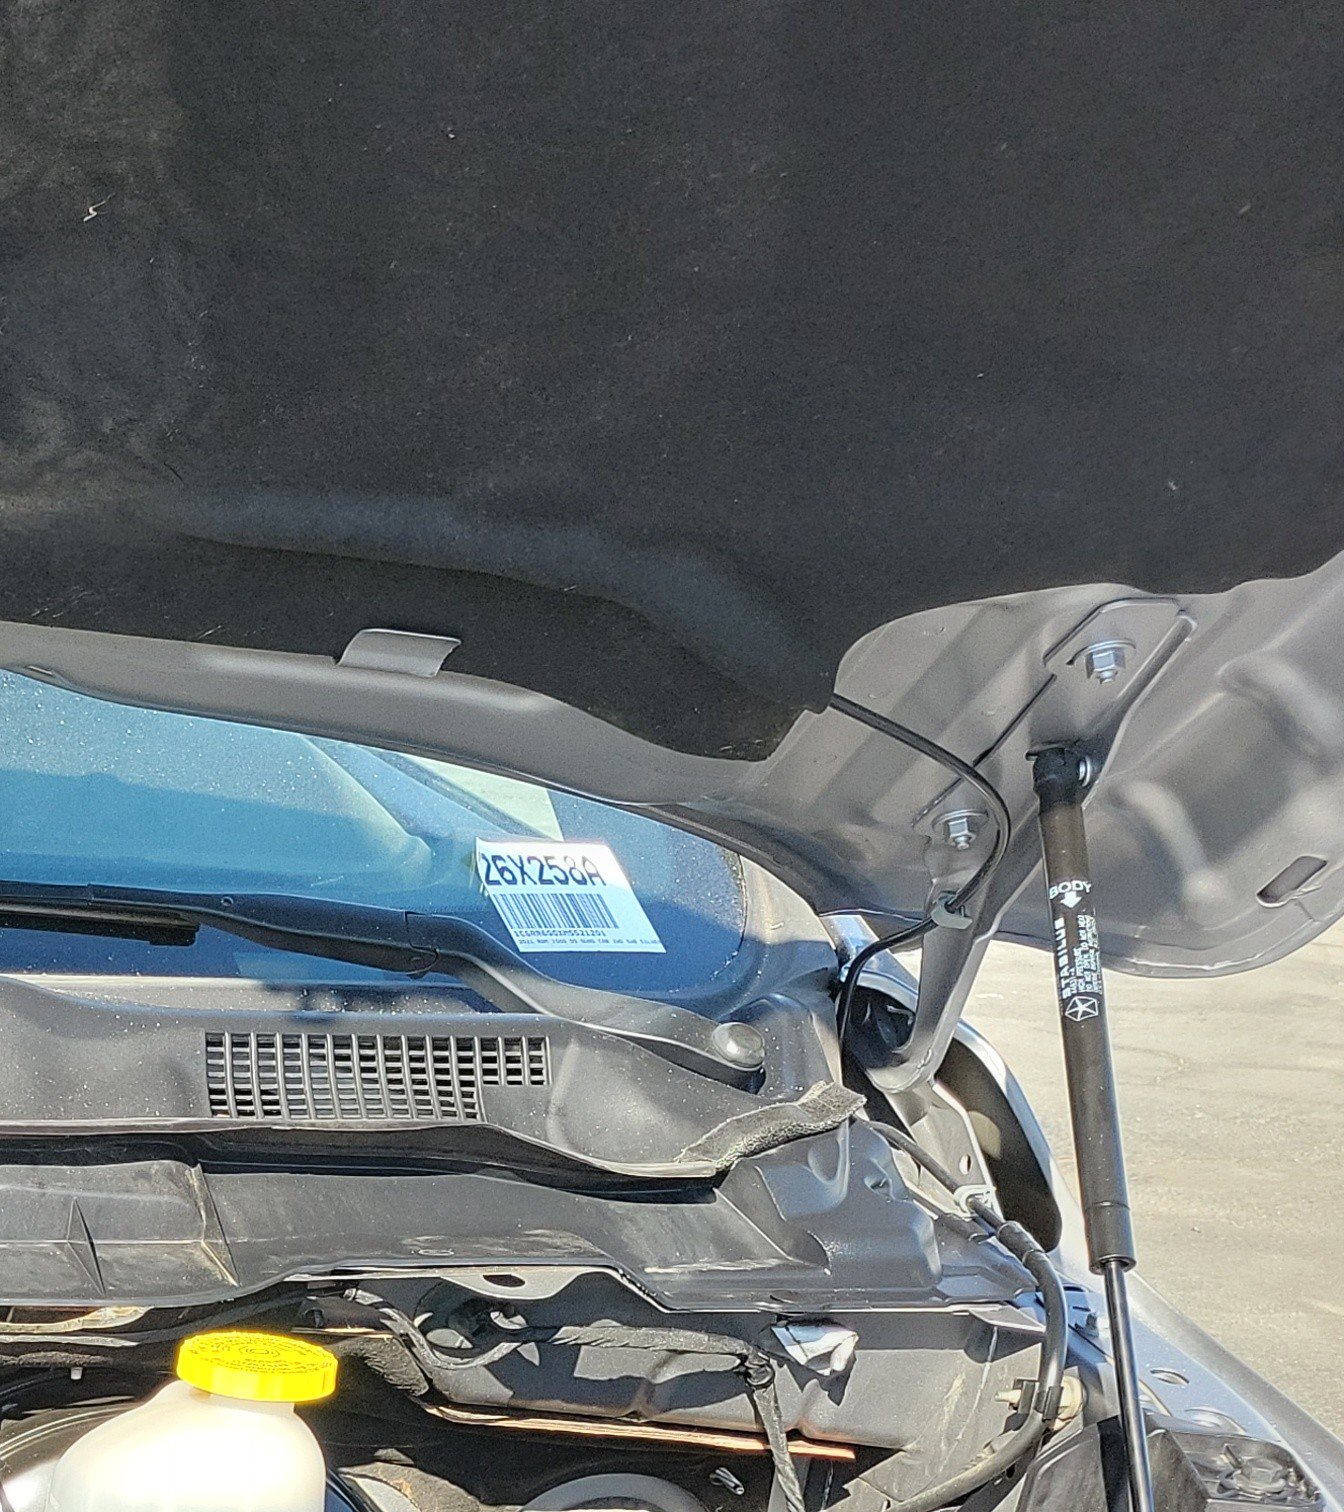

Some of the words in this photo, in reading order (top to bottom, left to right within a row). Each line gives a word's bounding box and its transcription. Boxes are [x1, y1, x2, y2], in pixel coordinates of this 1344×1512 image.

[480, 853, 607, 886] 26X258A
[1048, 879, 1092, 900] BODY
[1054, 916, 1072, 1000] STABILUS
